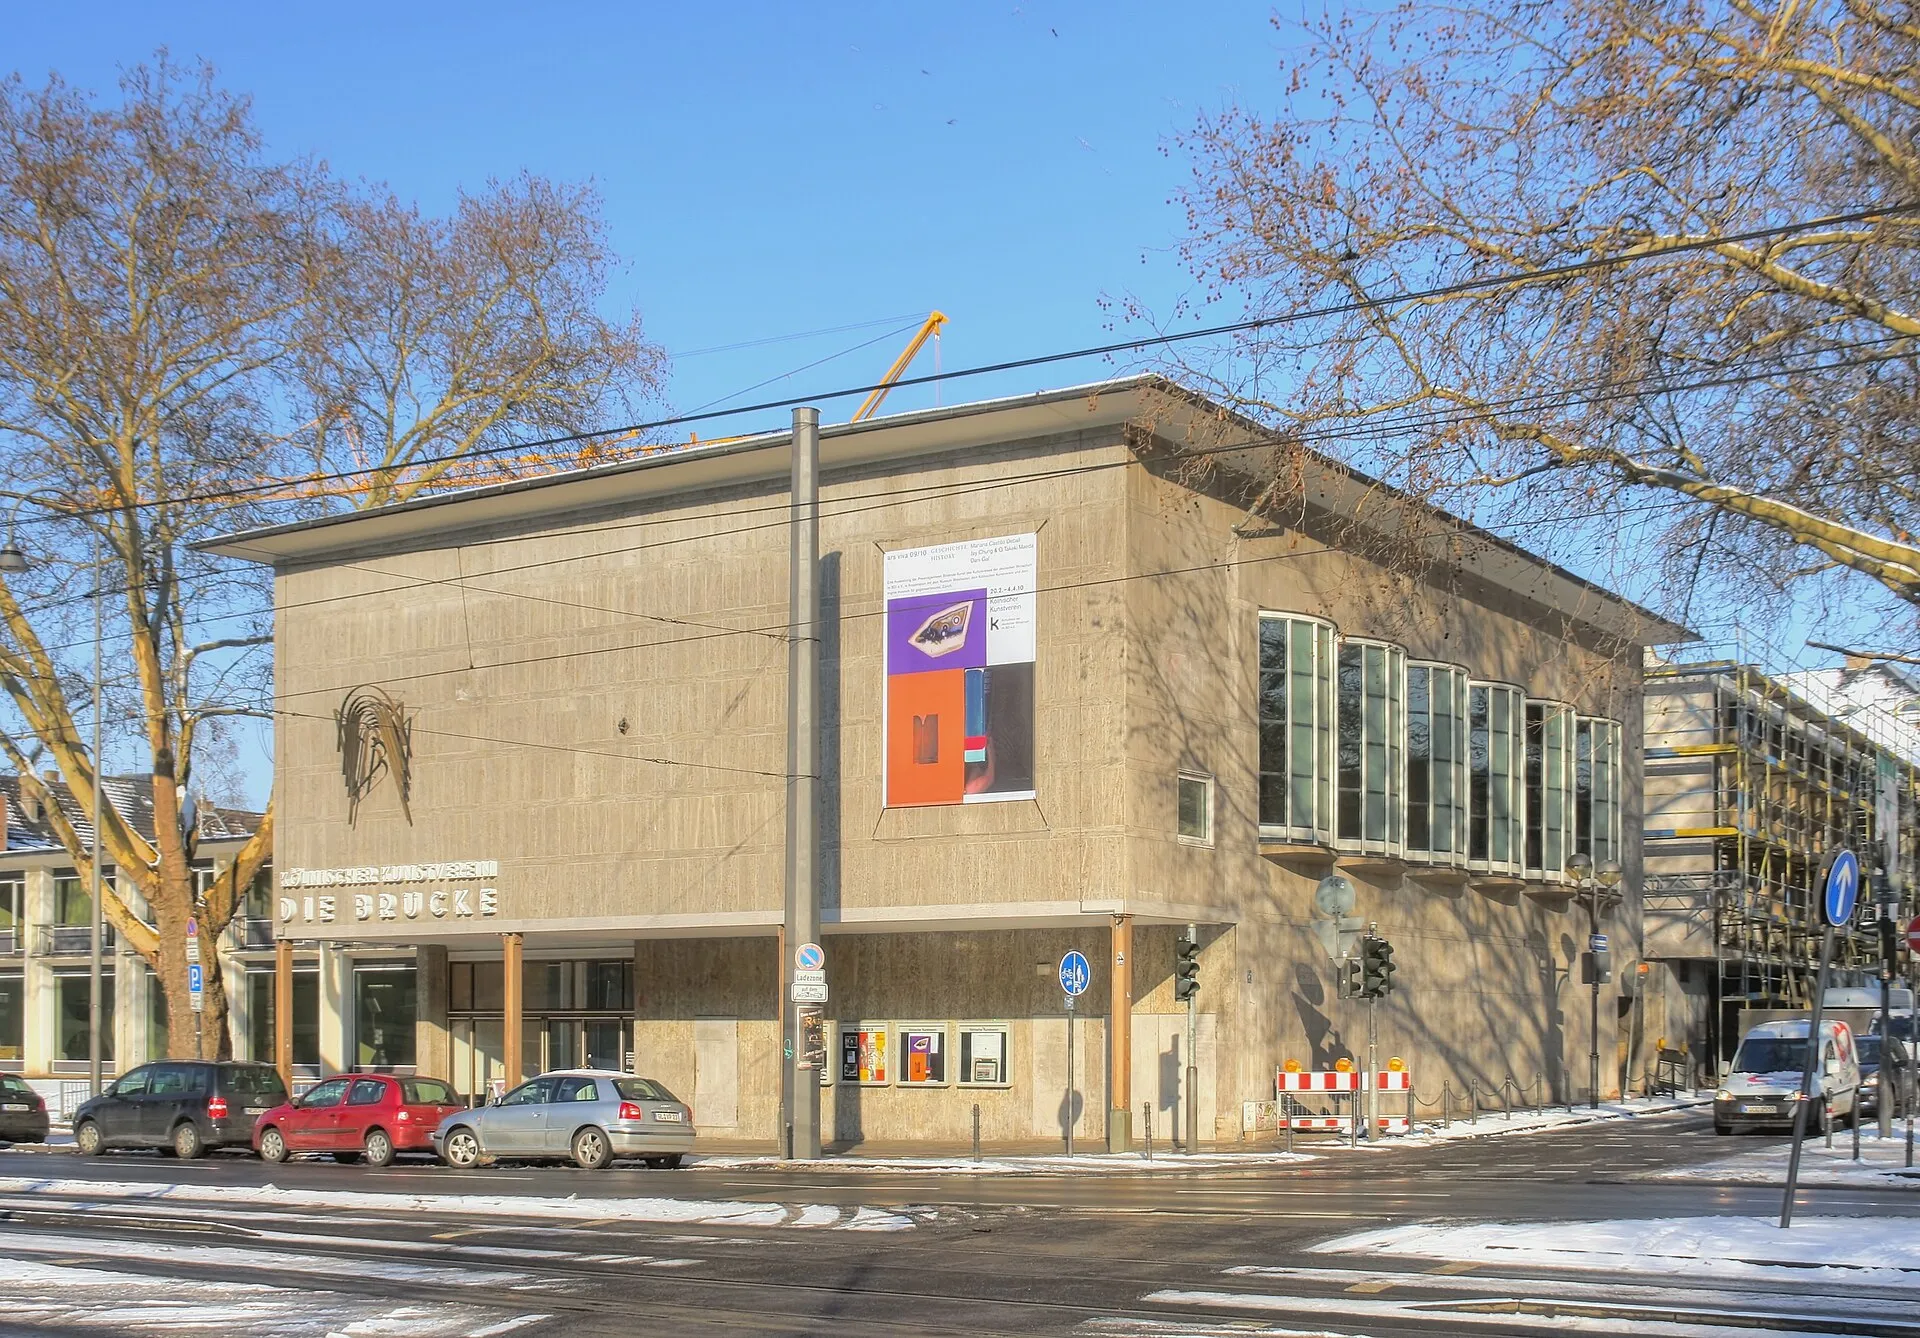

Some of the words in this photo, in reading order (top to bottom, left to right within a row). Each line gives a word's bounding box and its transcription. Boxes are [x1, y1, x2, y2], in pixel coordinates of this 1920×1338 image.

[380, 860, 498, 884] KUNSTVEREIN
[280, 895, 336, 922] DIE
[796, 974, 823, 982] Ladezone
